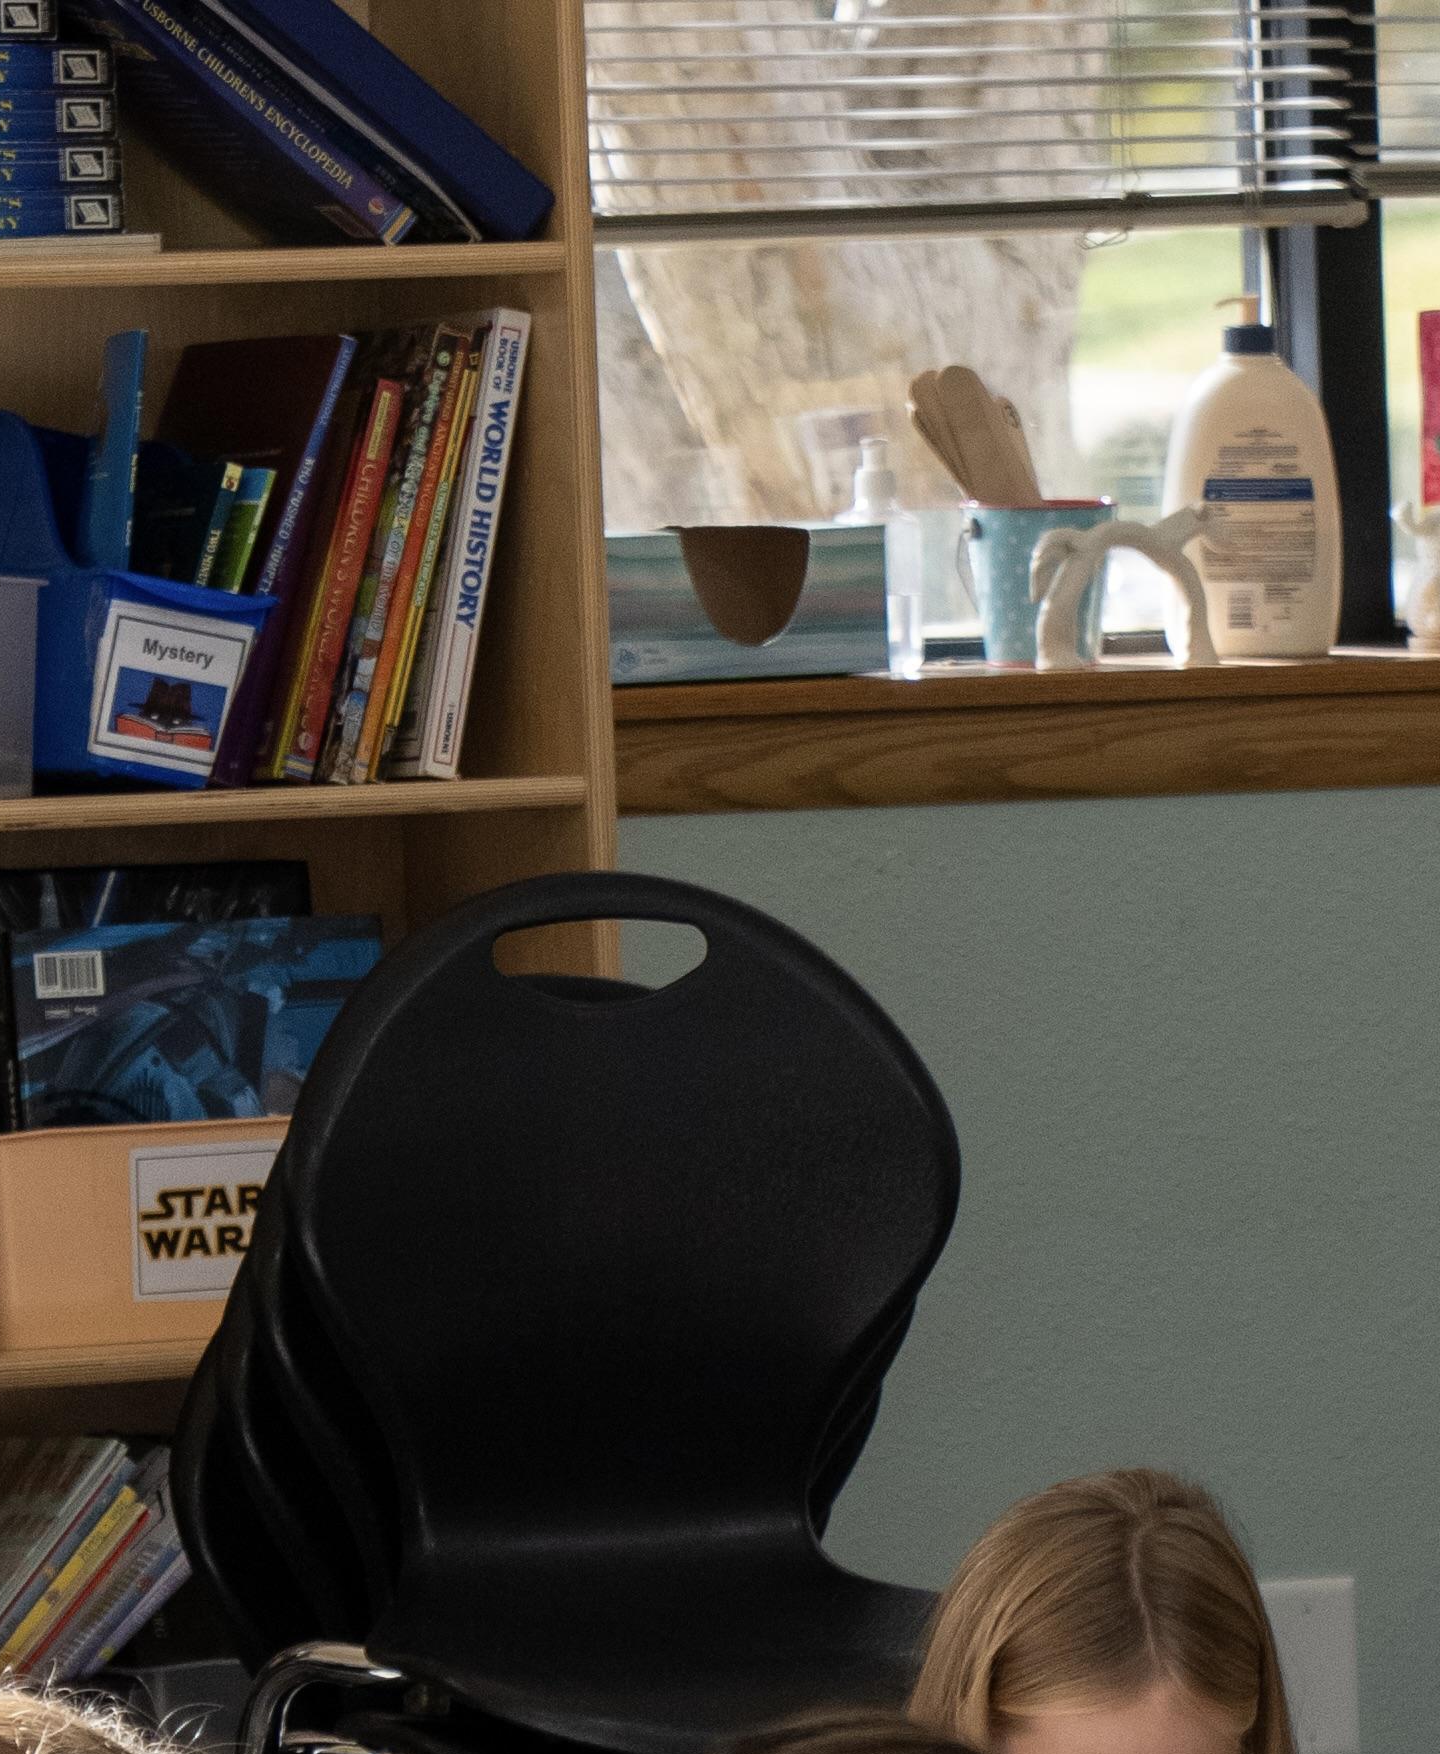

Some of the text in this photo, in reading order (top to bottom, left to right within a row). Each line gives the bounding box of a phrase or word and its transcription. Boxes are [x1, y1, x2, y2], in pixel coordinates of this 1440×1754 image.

[142, 2, 198, 53] USBORNE
[197, 46, 265, 111] CHILDREN'S
[263, 104, 354, 189] ENCYCLOPEDIA
[492, 338, 510, 392] BOOK OF
[503, 340, 521, 395] USBORNE
[259, 457, 316, 597] WHO PUSHED HUMPTY
[455, 400, 511, 632] WORLD HISTORY
[206, 527, 222, 554] TWO
[141, 637, 215, 670] Mystery
[442, 712, 456, 754] USBORNE
[140, 1184, 265, 1222] STAR
[140, 1222, 257, 1264] WAR
